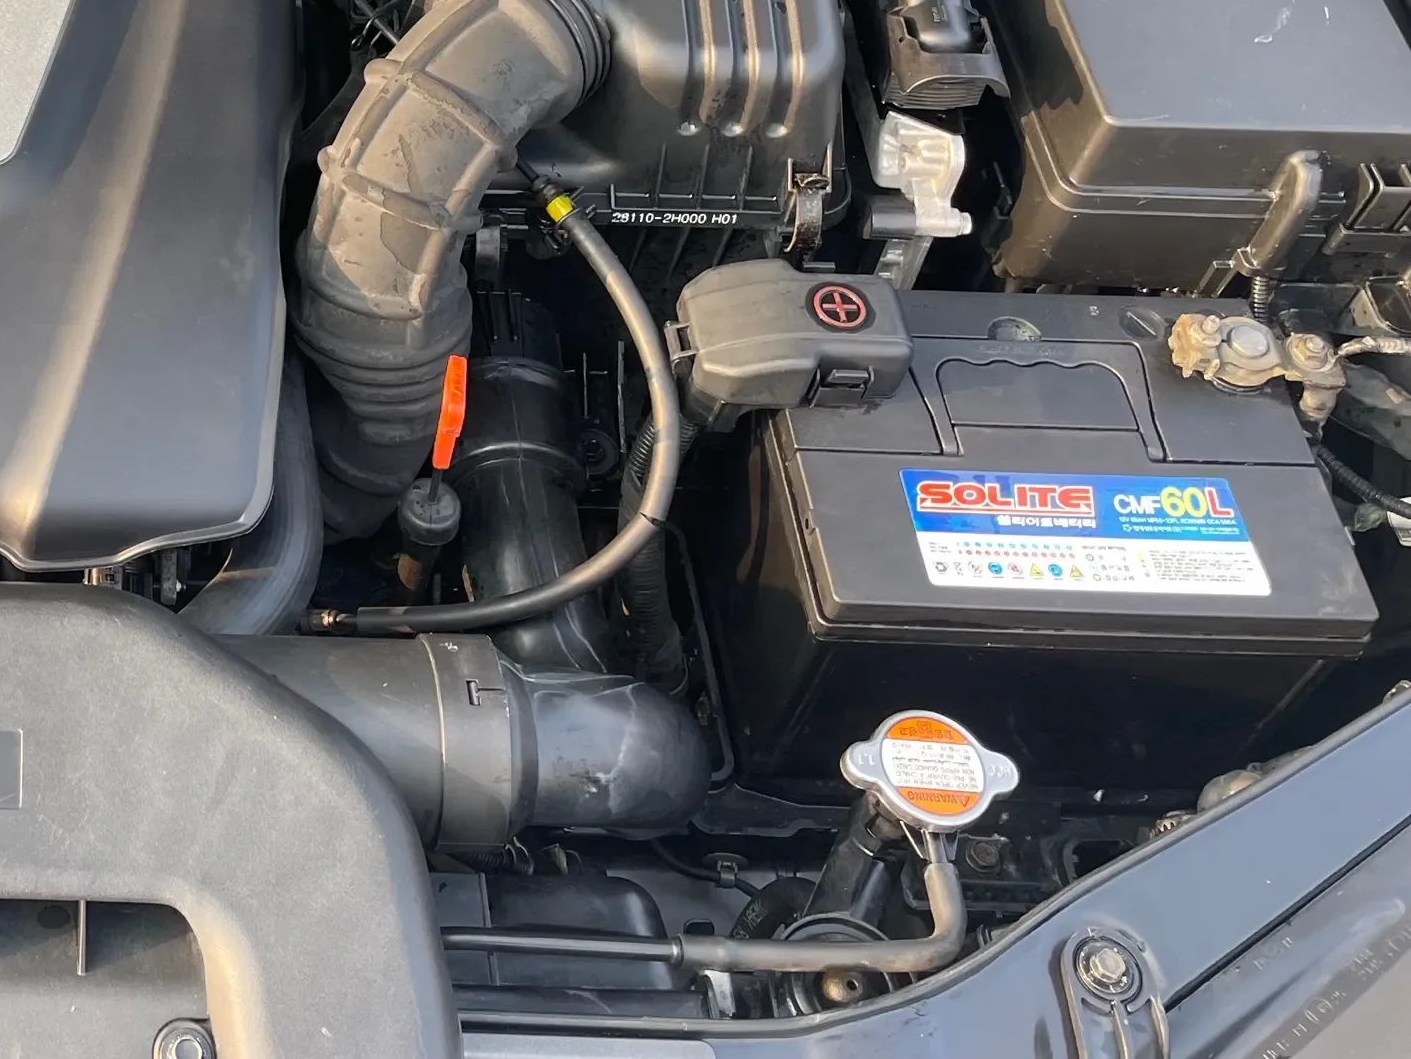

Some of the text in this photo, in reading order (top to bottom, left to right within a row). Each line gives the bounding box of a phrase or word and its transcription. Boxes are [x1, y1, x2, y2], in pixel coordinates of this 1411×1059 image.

[611, 212, 737, 224] 28110-2H000 H01
[917, 482, 1094, 514] SOLITE
[907, 791, 957, 804] WARNING
